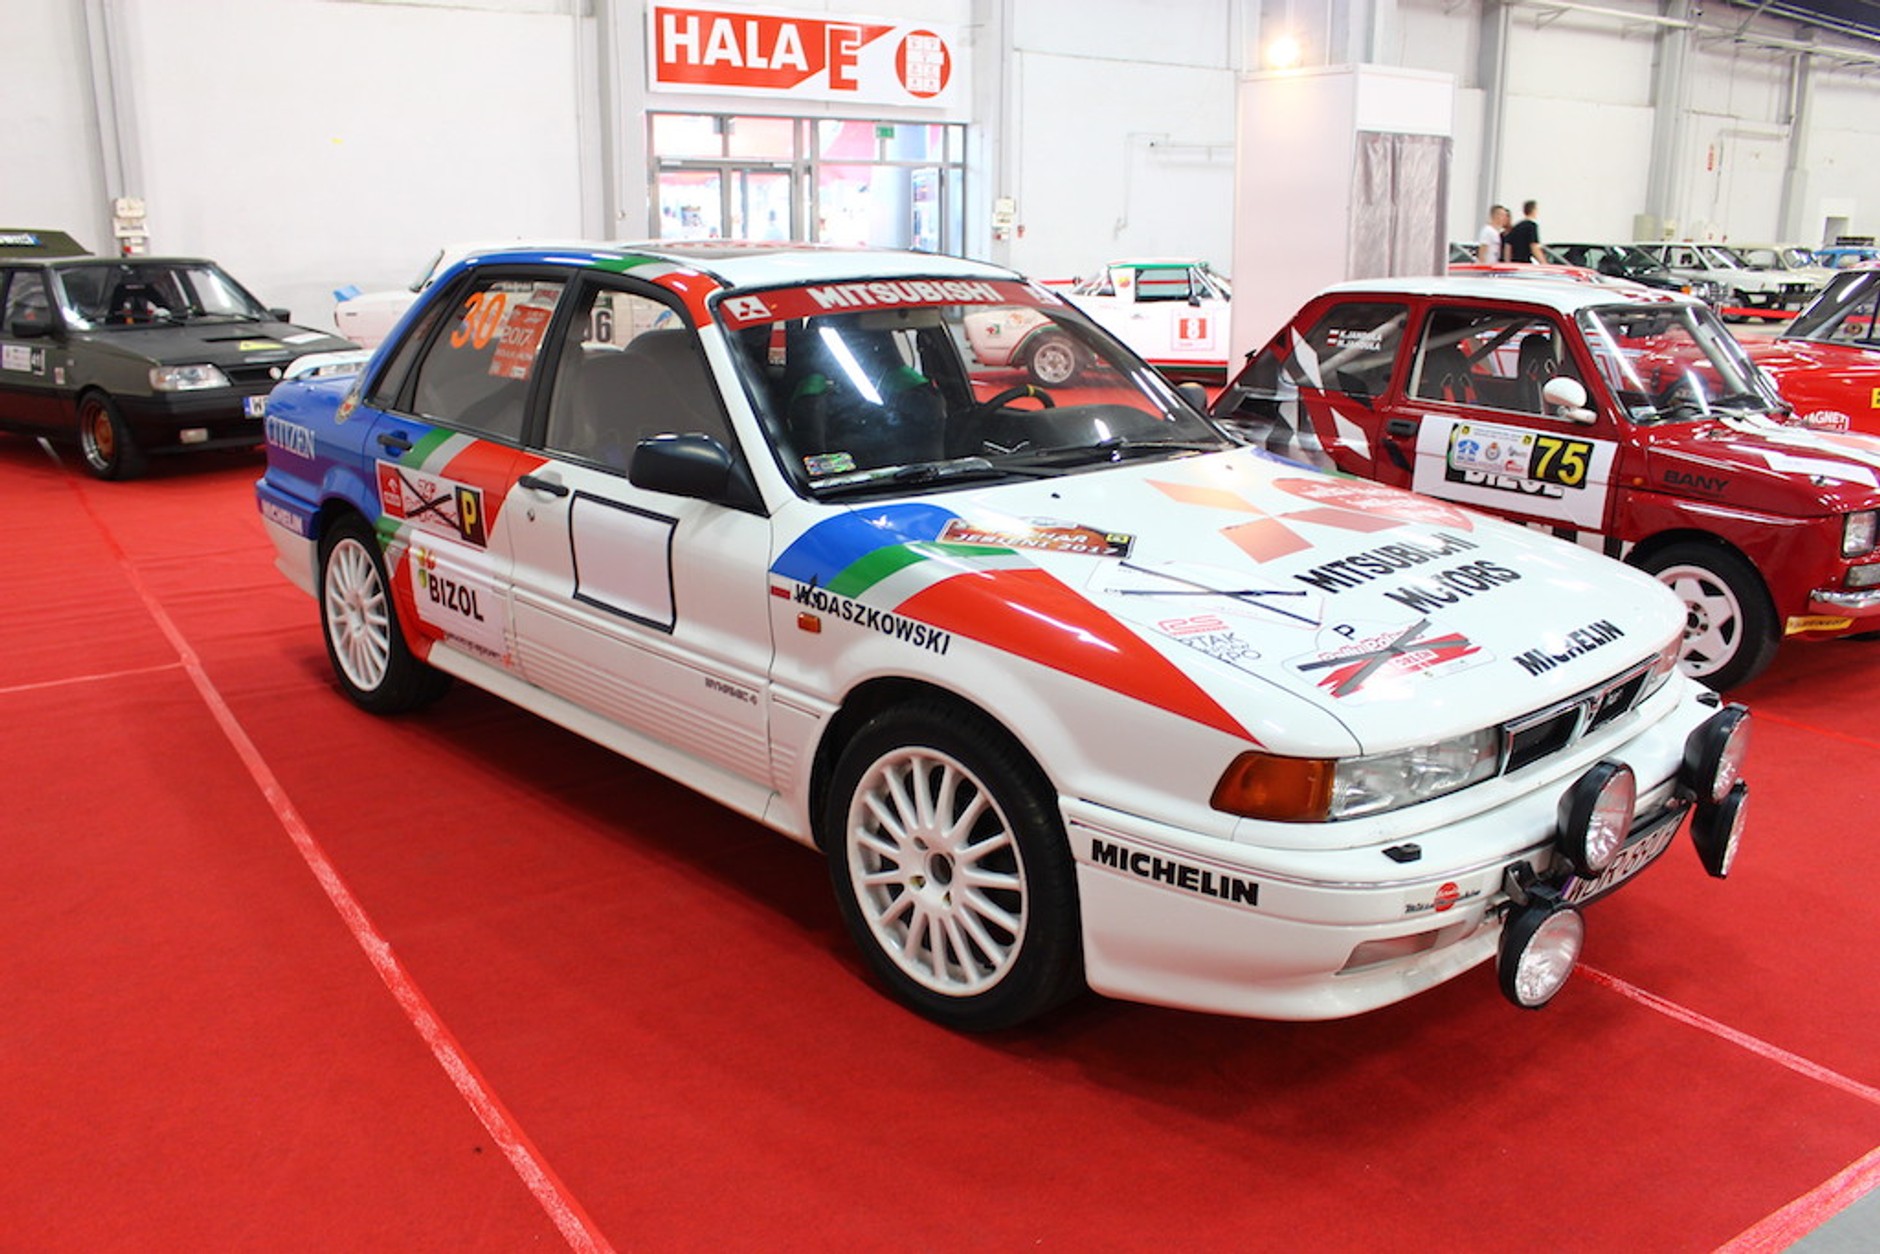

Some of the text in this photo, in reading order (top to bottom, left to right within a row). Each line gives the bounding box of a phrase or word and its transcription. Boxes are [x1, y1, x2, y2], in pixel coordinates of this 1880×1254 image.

[663, 14, 862, 91] HALA E
[806, 281, 1005, 309] MITSUBISHI
[451, 292, 507, 349] 30
[500, 325, 535, 346] 2017
[1188, 319, 1200, 339] 8
[266, 414, 315, 460] CITIZEN
[1535, 436, 1589, 486] 75
[1664, 469, 1729, 492] BANY
[461, 490, 477, 535] P
[1056, 542, 1119, 556] 2017
[428, 573, 485, 622] BIZOL
[1332, 623, 1356, 641] P
[1091, 838, 1260, 906] MICHELIN
